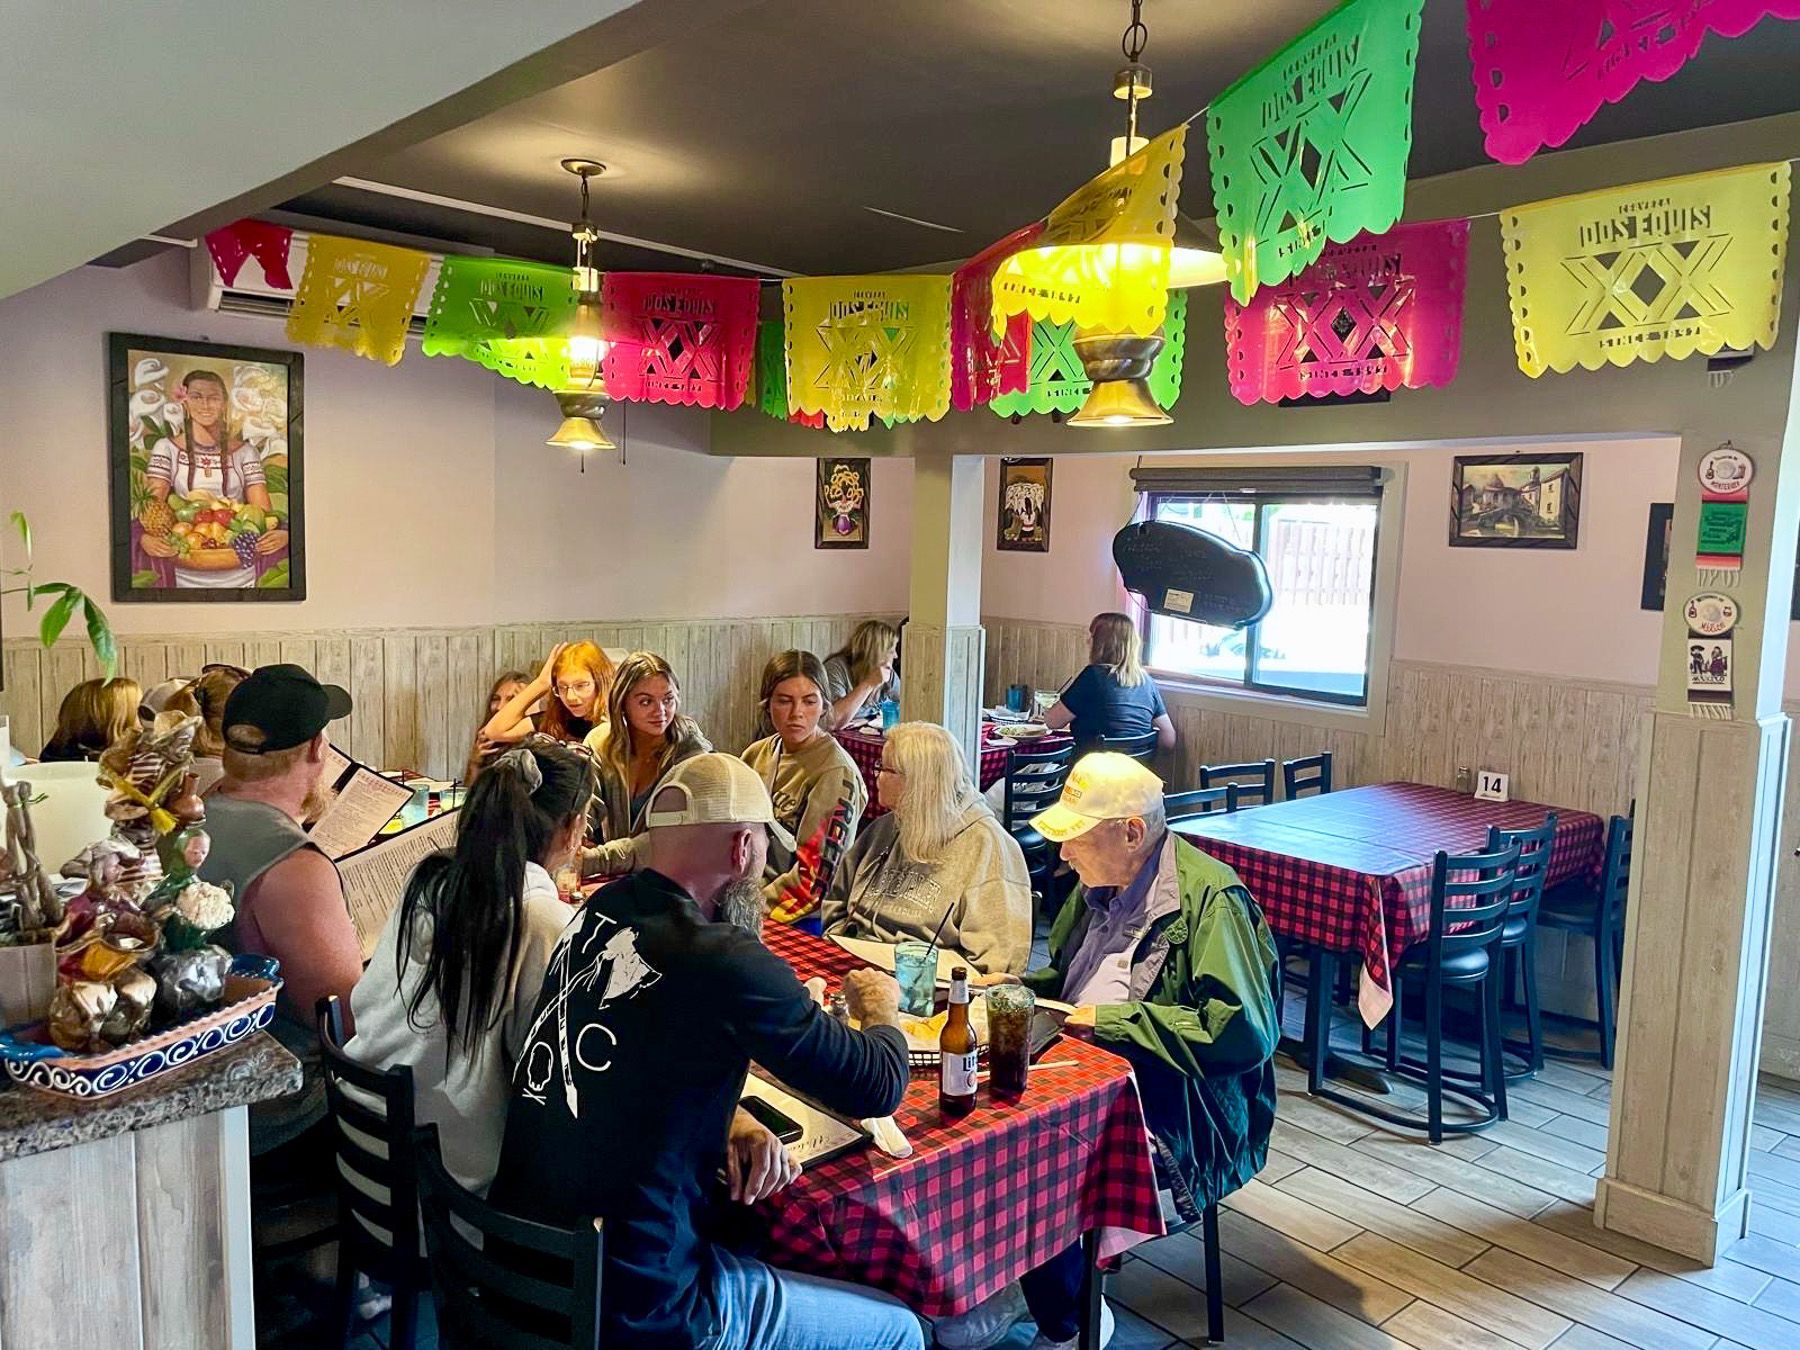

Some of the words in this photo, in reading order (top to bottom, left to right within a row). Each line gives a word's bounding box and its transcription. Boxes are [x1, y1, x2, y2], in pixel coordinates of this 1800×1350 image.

[1580, 216, 1630, 248] DOS
[1636, 205, 1711, 238] EQUIS
[643, 293, 672, 311] DOS
[675, 298, 716, 315] EQUIS
[1483, 776, 1502, 793] 14
